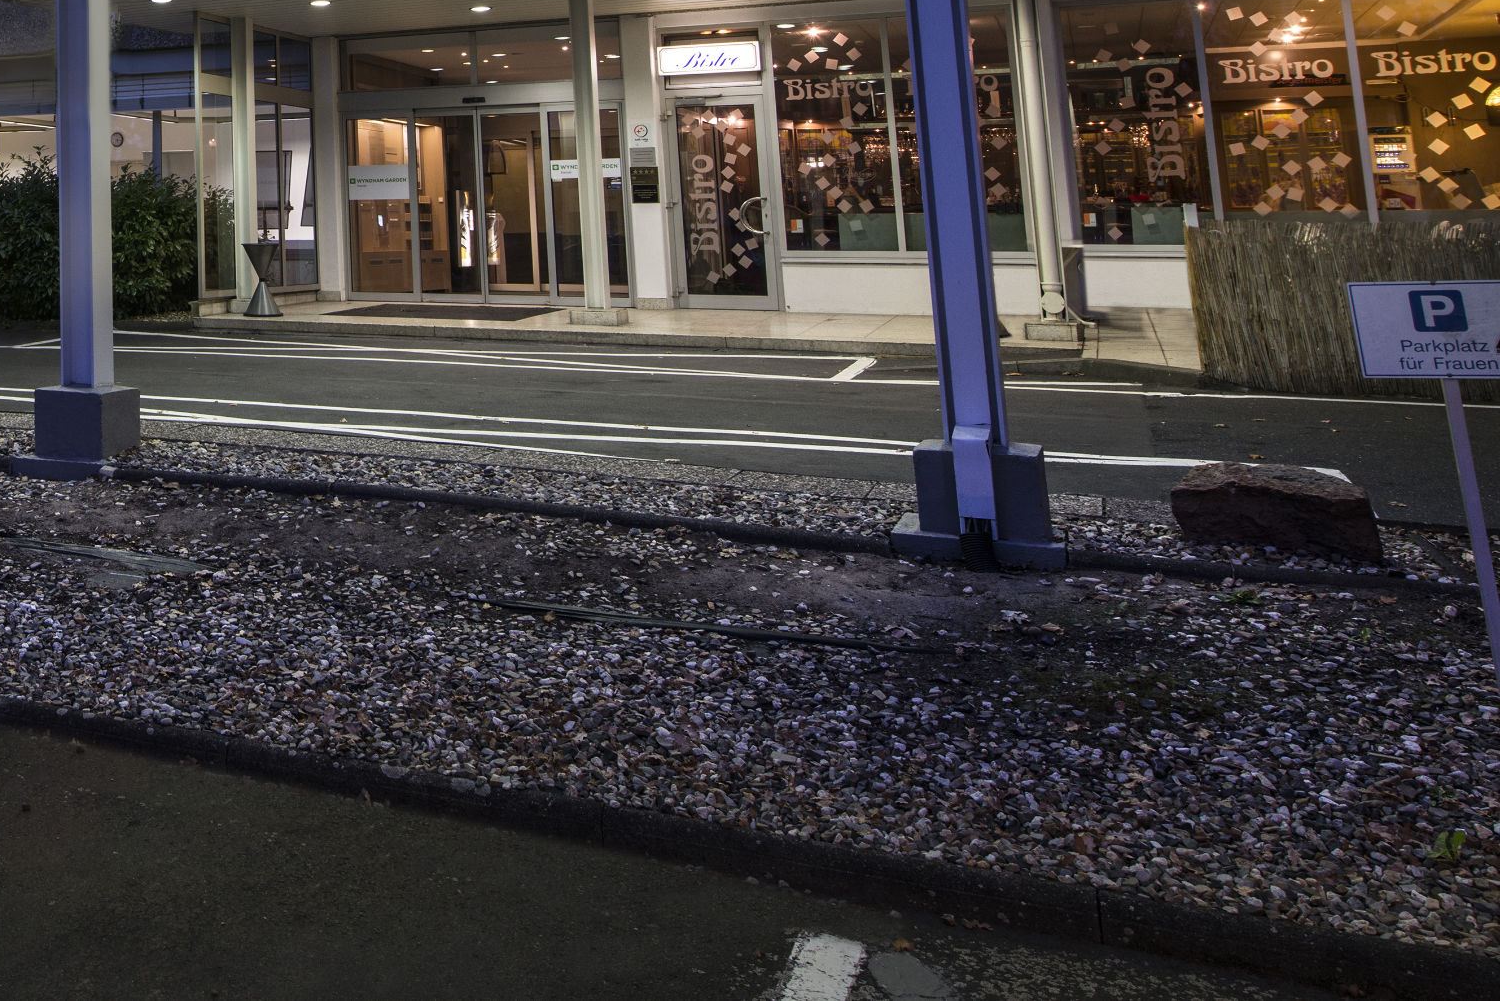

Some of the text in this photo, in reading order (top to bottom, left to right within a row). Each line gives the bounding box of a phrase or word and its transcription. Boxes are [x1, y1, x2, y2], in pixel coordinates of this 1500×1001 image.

[676, 51, 741, 70] Bistro
[1218, 55, 1334, 84] Bistro
[1370, 49, 1497, 77] Bistro
[783, 77, 873, 101] Bistro
[1141, 67, 1186, 183] Bistro
[690, 154, 720, 256] Bistro
[1420, 295, 1455, 327] P
[1400, 340, 1490, 355] Parkplatz
[1399, 357, 1499, 370] für Frauen
